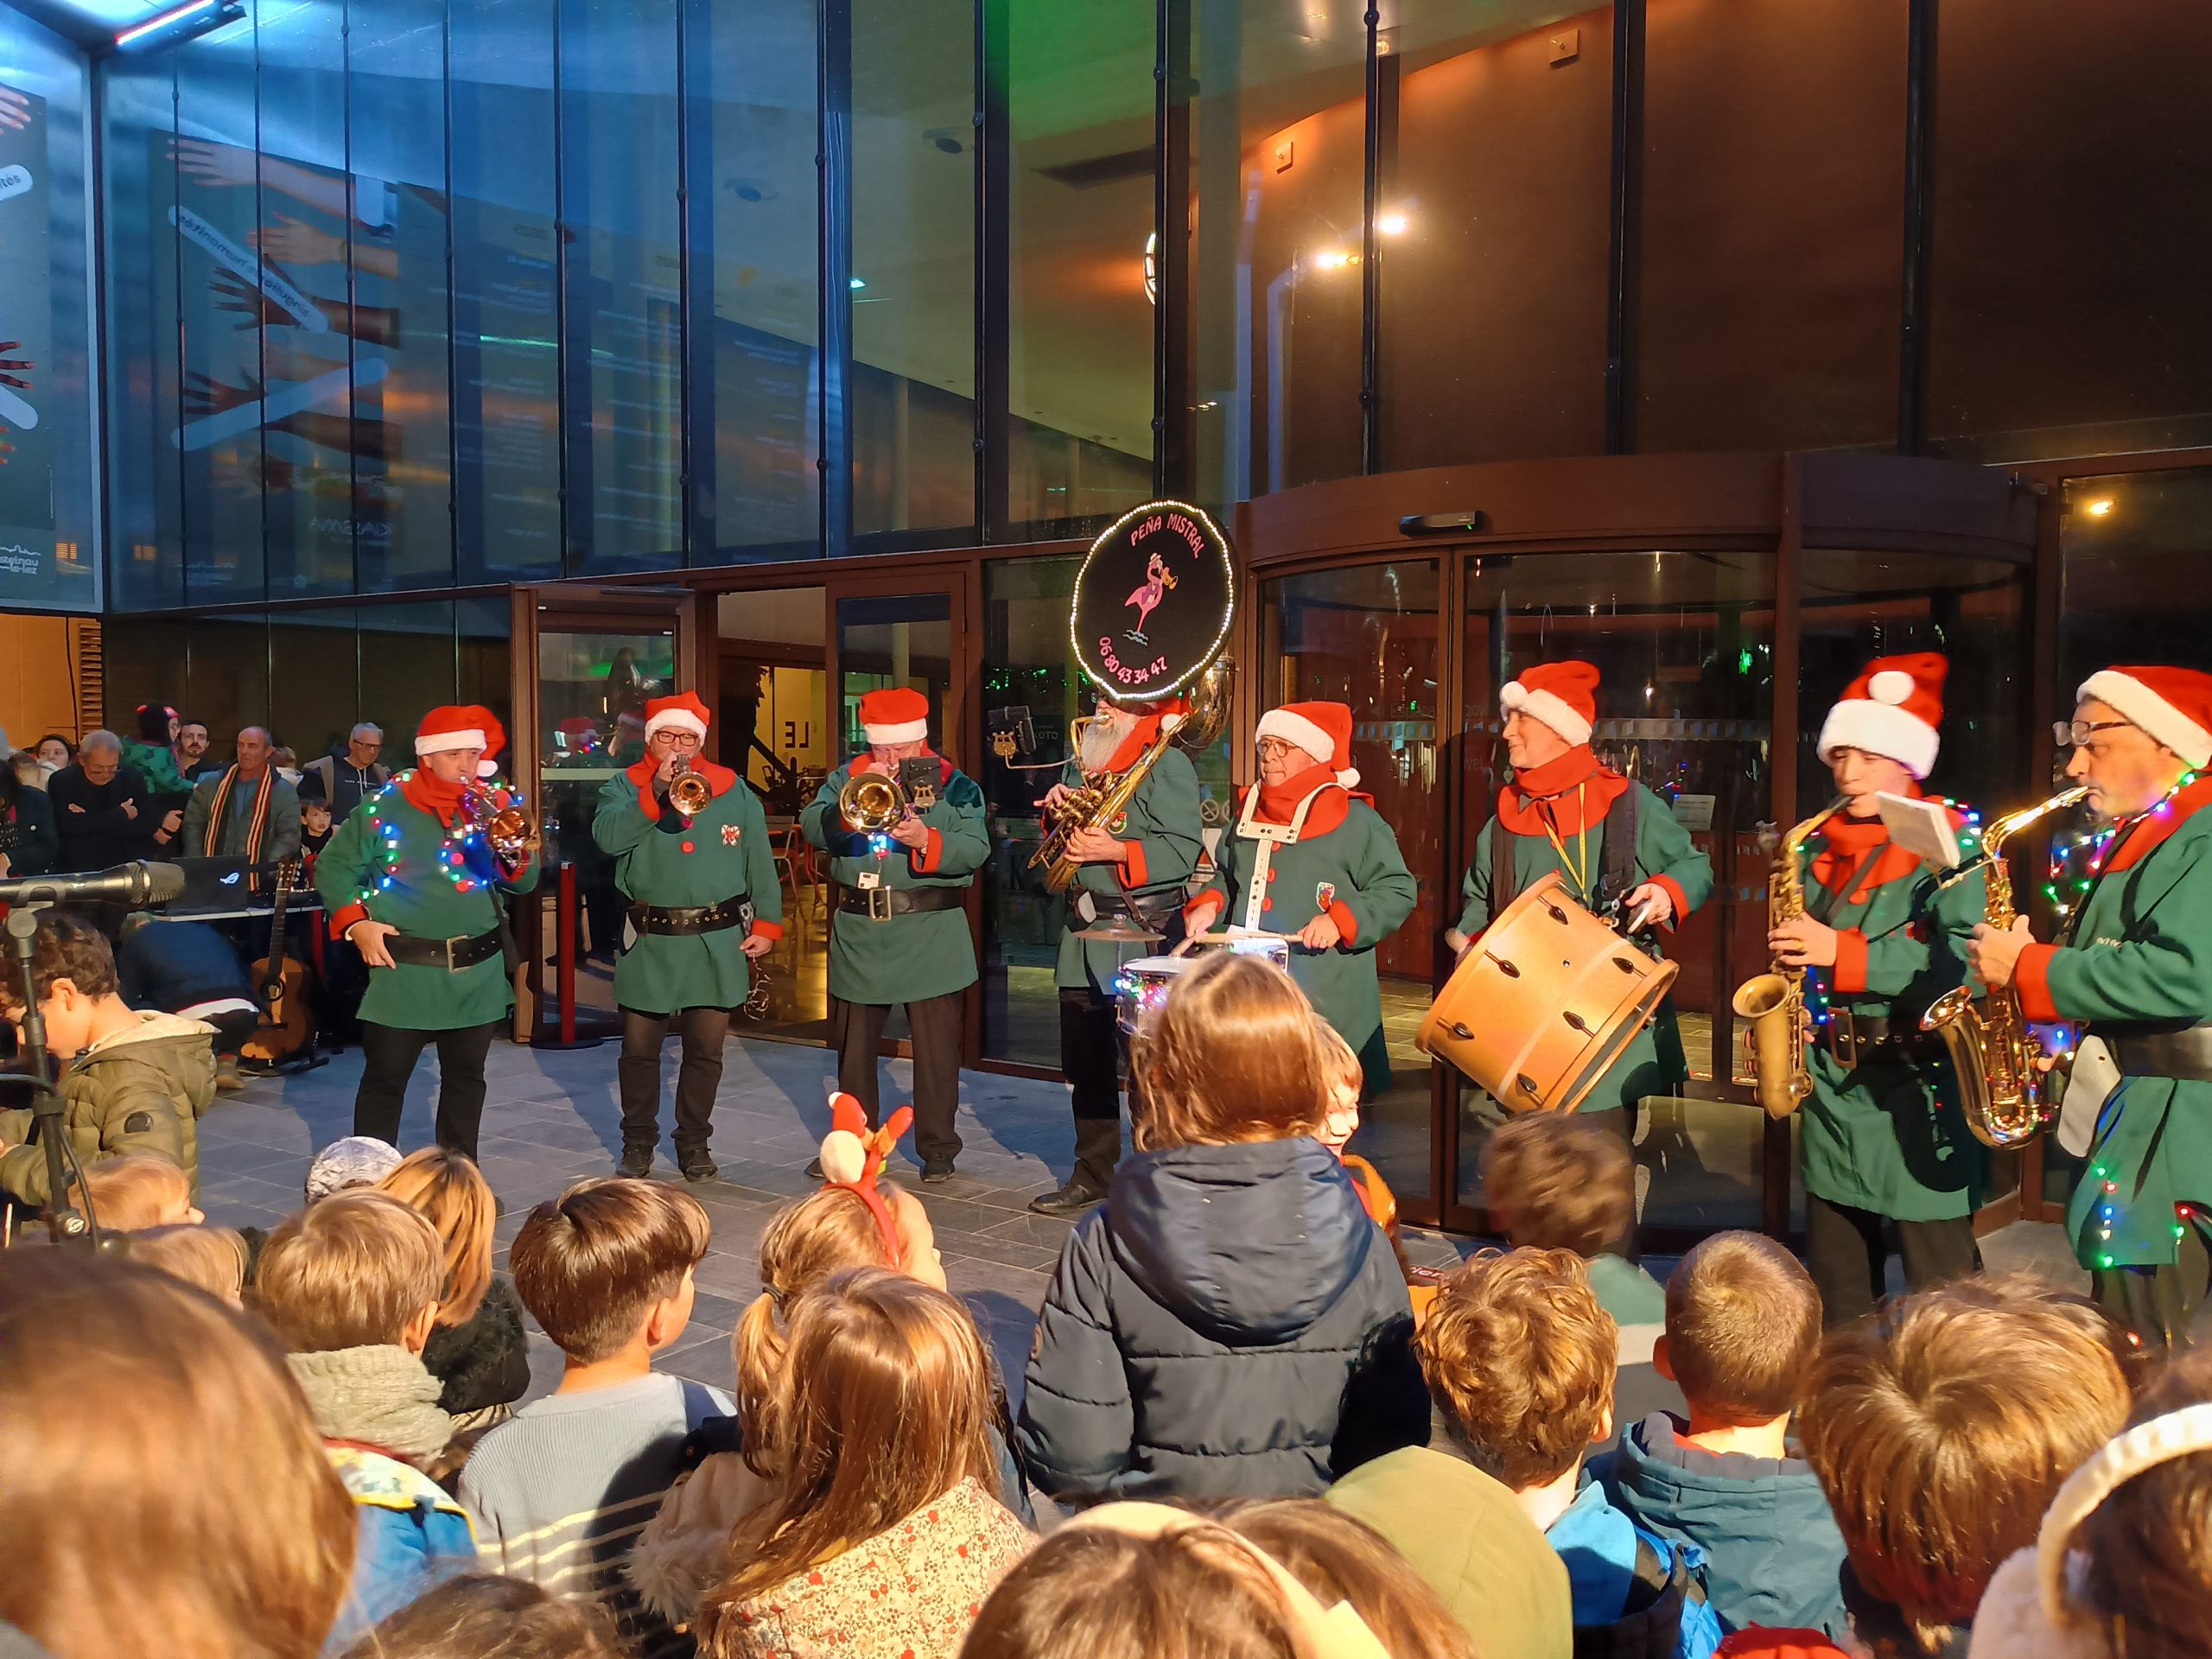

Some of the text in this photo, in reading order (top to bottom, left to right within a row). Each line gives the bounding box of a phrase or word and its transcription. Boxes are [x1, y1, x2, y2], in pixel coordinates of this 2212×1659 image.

[1130, 513, 1205, 559] PEÑA MISTRAL
[1099, 636, 1168, 684] 06 80 43 34 47
